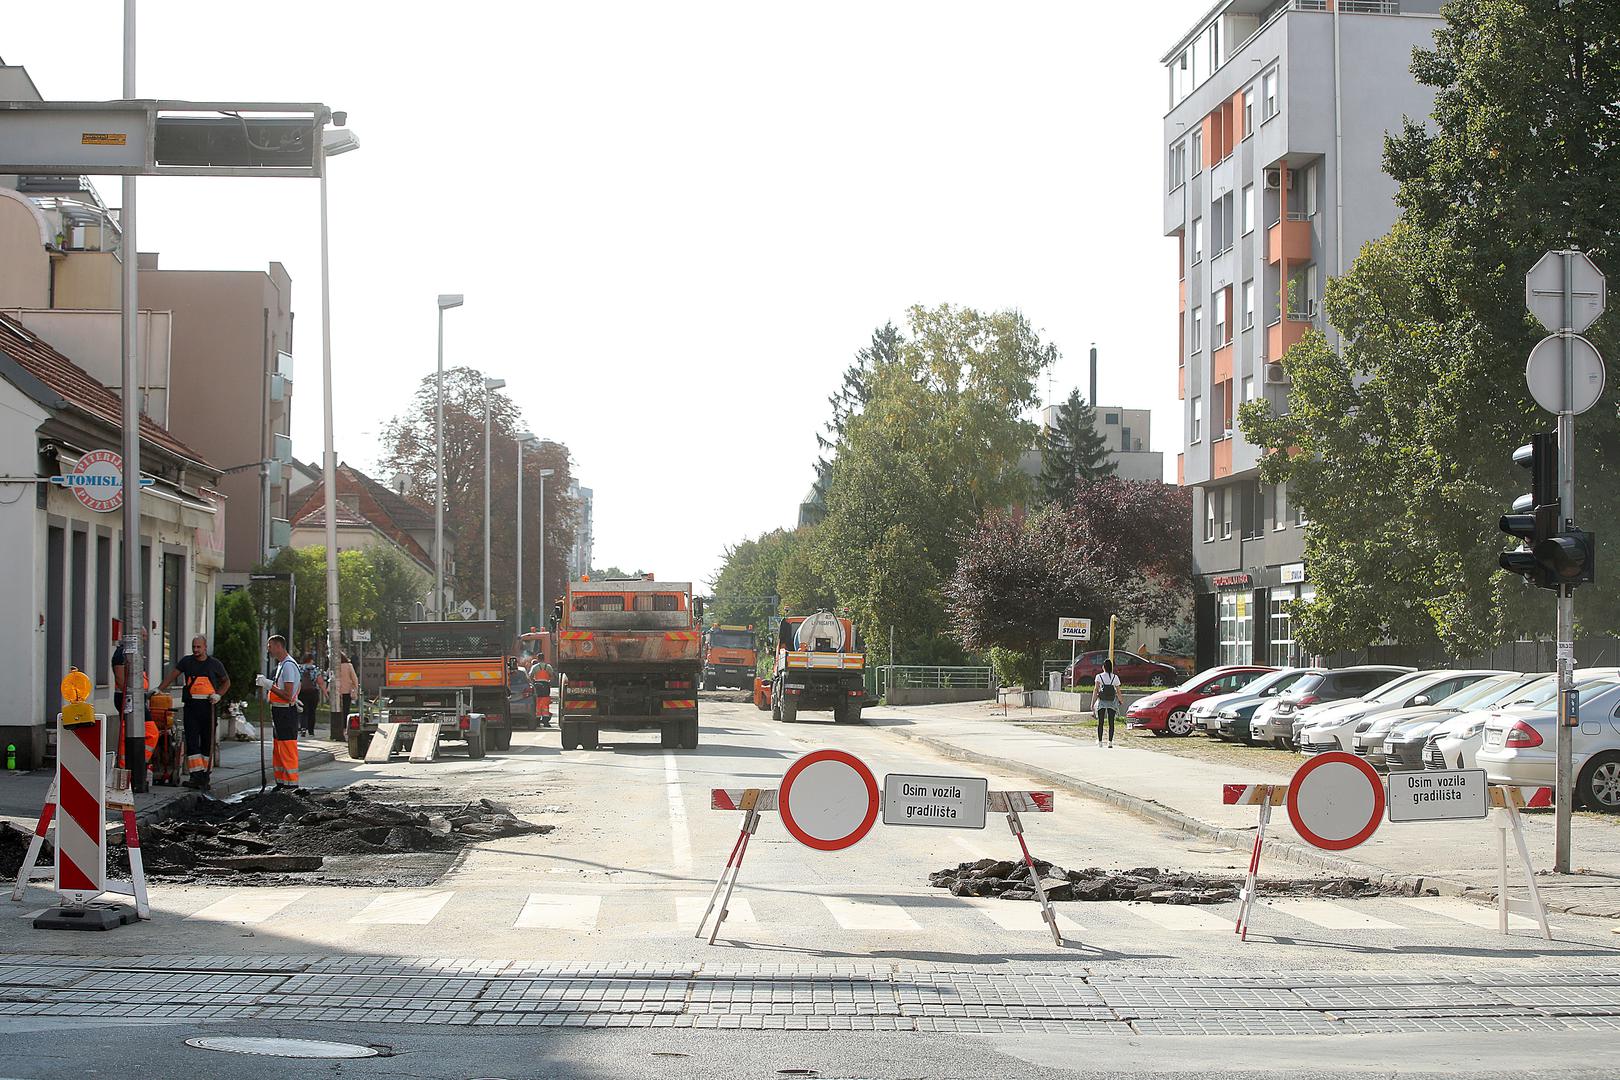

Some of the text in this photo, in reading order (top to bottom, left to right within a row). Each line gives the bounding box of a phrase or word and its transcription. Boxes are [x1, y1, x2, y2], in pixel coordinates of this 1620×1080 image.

[78, 452, 123, 471] PITERIJ
[66, 475, 123, 487] TOMISL
[77, 490, 123, 509] PIZZERI
[1408, 775, 1466, 788] Osim vozila
[903, 783, 961, 798] Osim vozila
[1413, 789, 1461, 804] gradilišta
[906, 804, 957, 818] gradilišta
